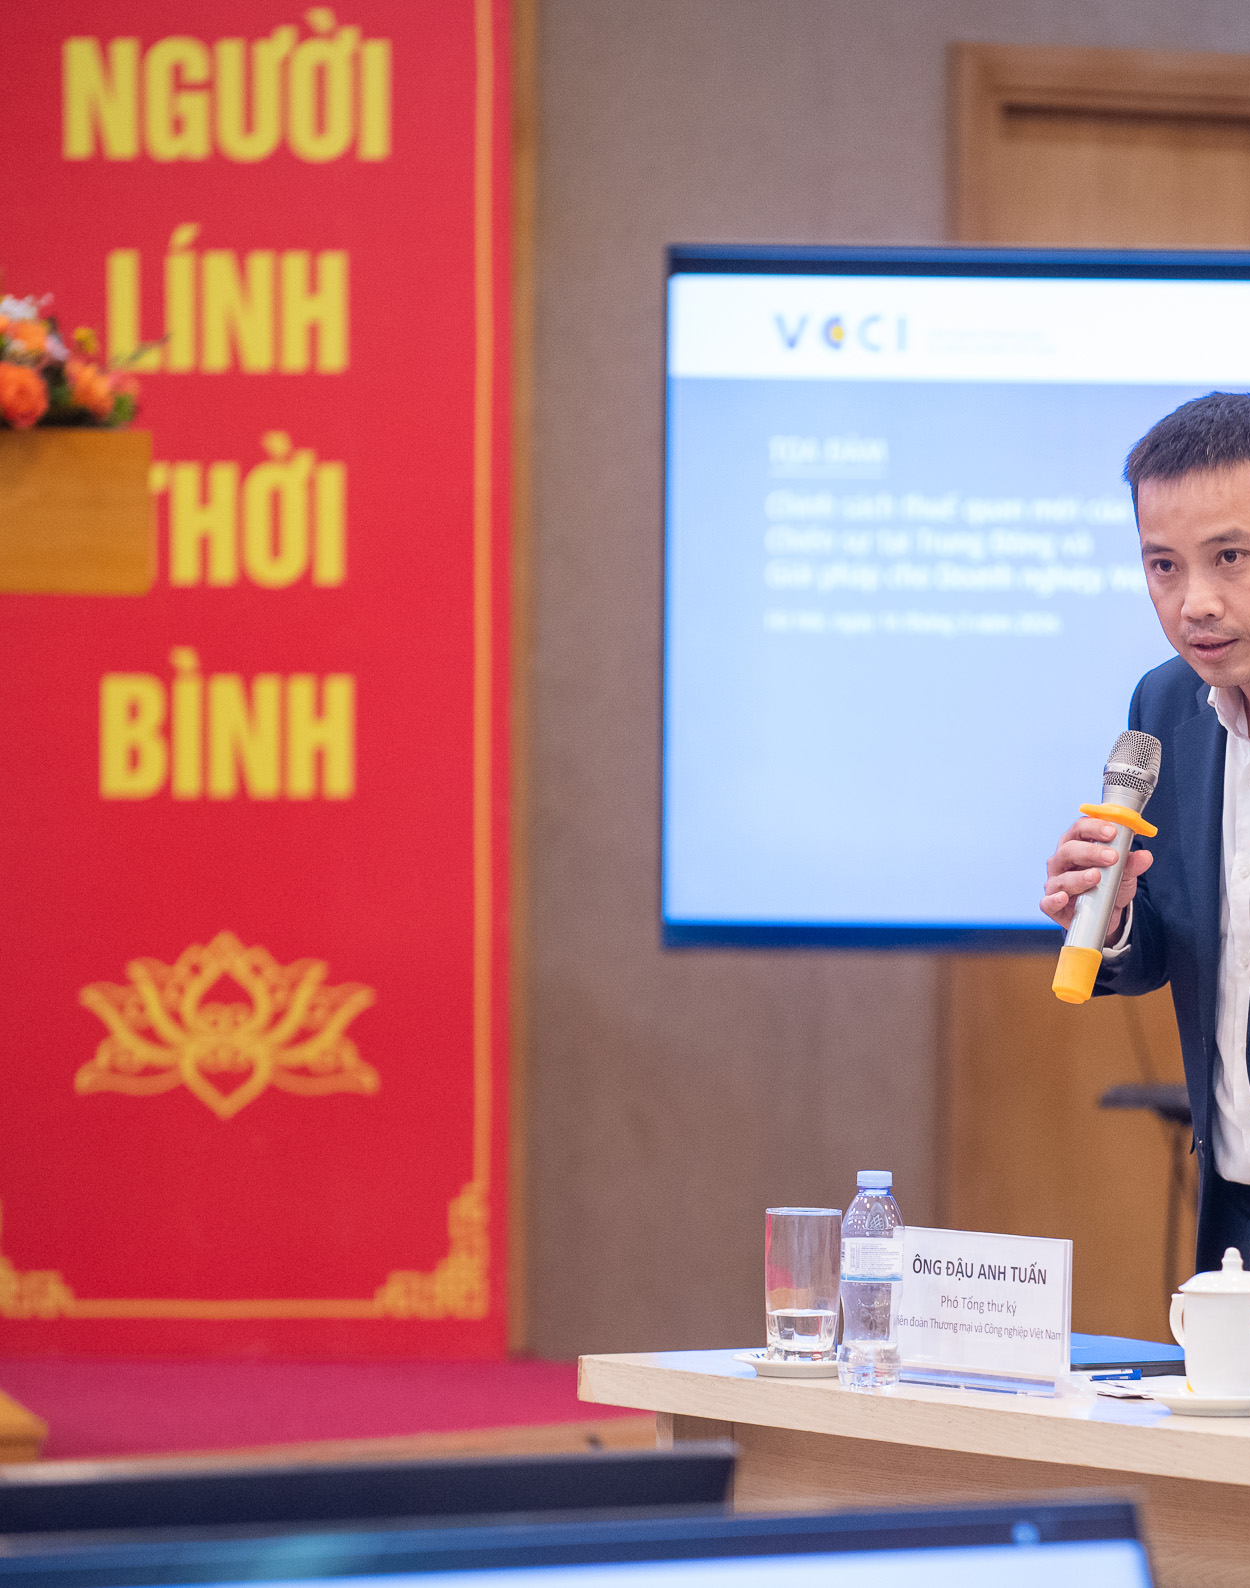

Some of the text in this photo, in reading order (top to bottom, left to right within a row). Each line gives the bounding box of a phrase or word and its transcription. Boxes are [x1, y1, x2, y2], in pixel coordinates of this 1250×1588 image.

[62, 7, 392, 162] NGƯỜI
[106, 222, 350, 374] LÍNH
[99, 645, 356, 800] BÌNH
[912, 1254, 942, 1276] ÔNG
[946, 1257, 974, 1281] ĐẬU
[977, 1263, 1007, 1281] ANH
[1010, 1262, 1047, 1285] TUẤN
[940, 1295, 1017, 1317] Phó Tổng thư ký
[909, 1316, 929, 1328] đoàn
[929, 1318, 958, 1334] Thương
[959, 1321, 973, 1334] mại
[974, 1322, 983, 1334] và
[984, 1323, 1003, 1338] Công
[1004, 1326, 1028, 1340] nghiệp
[1029, 1328, 1044, 1340] Việt
